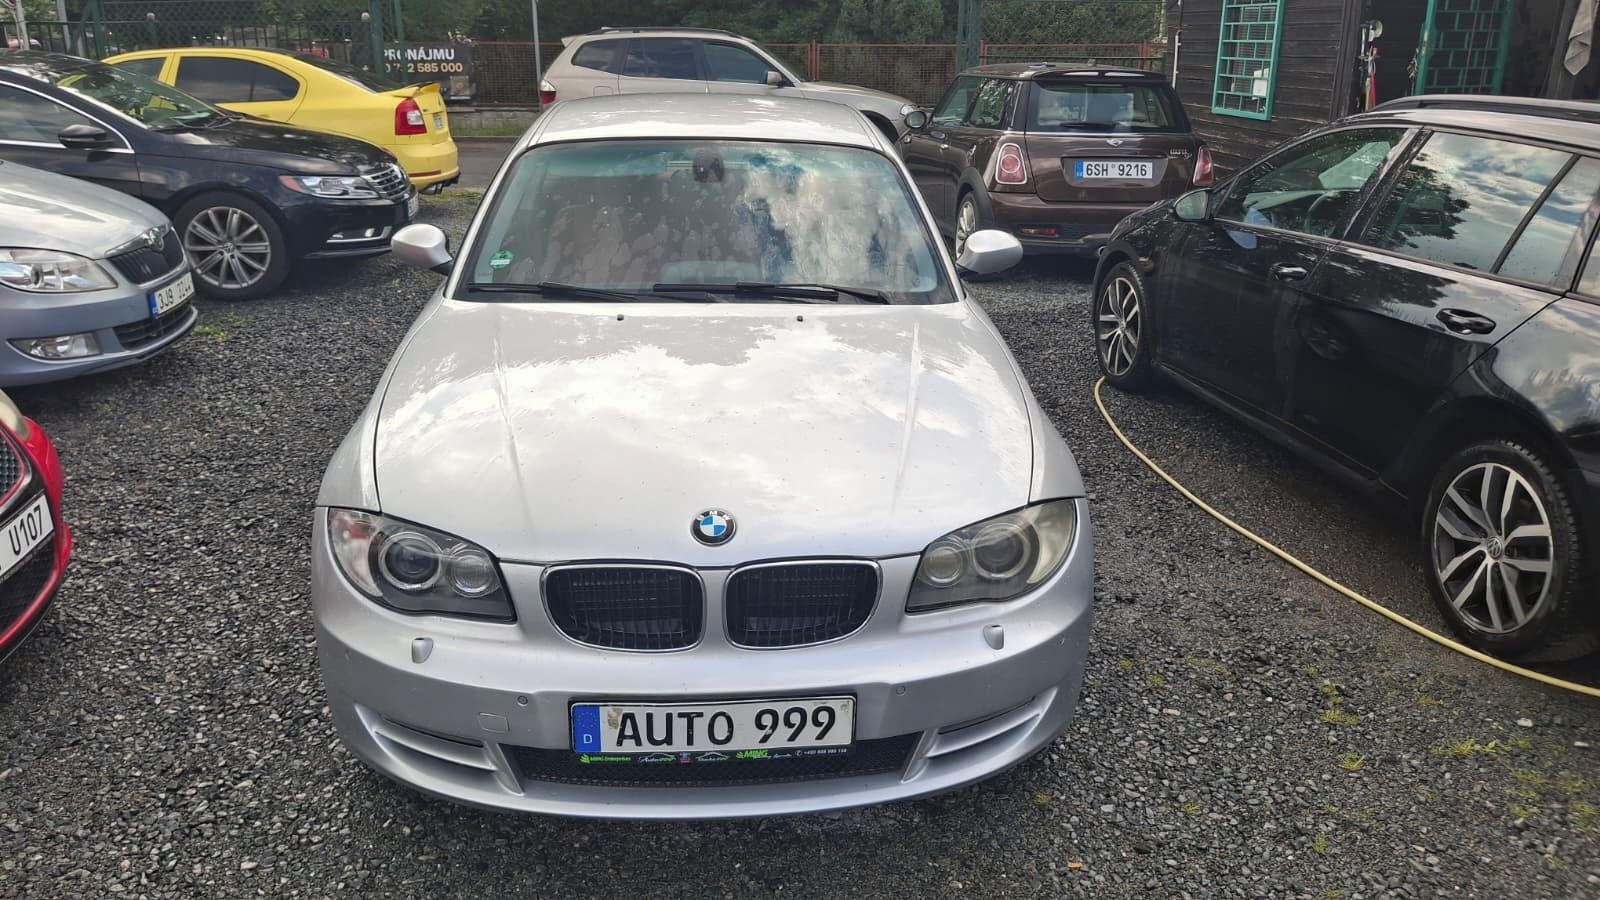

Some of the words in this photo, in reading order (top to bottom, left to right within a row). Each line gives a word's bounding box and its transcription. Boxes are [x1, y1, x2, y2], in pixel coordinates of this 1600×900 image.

[417, 63, 439, 73] 585
[440, 63, 463, 73] 000
[1086, 163, 1109, 177] 6SH
[1118, 164, 1147, 177] 9216
[8, 504, 43, 556] U107
[616, 711, 734, 746] AUTO
[754, 706, 836, 743] 999
[583, 734, 593, 744] D
